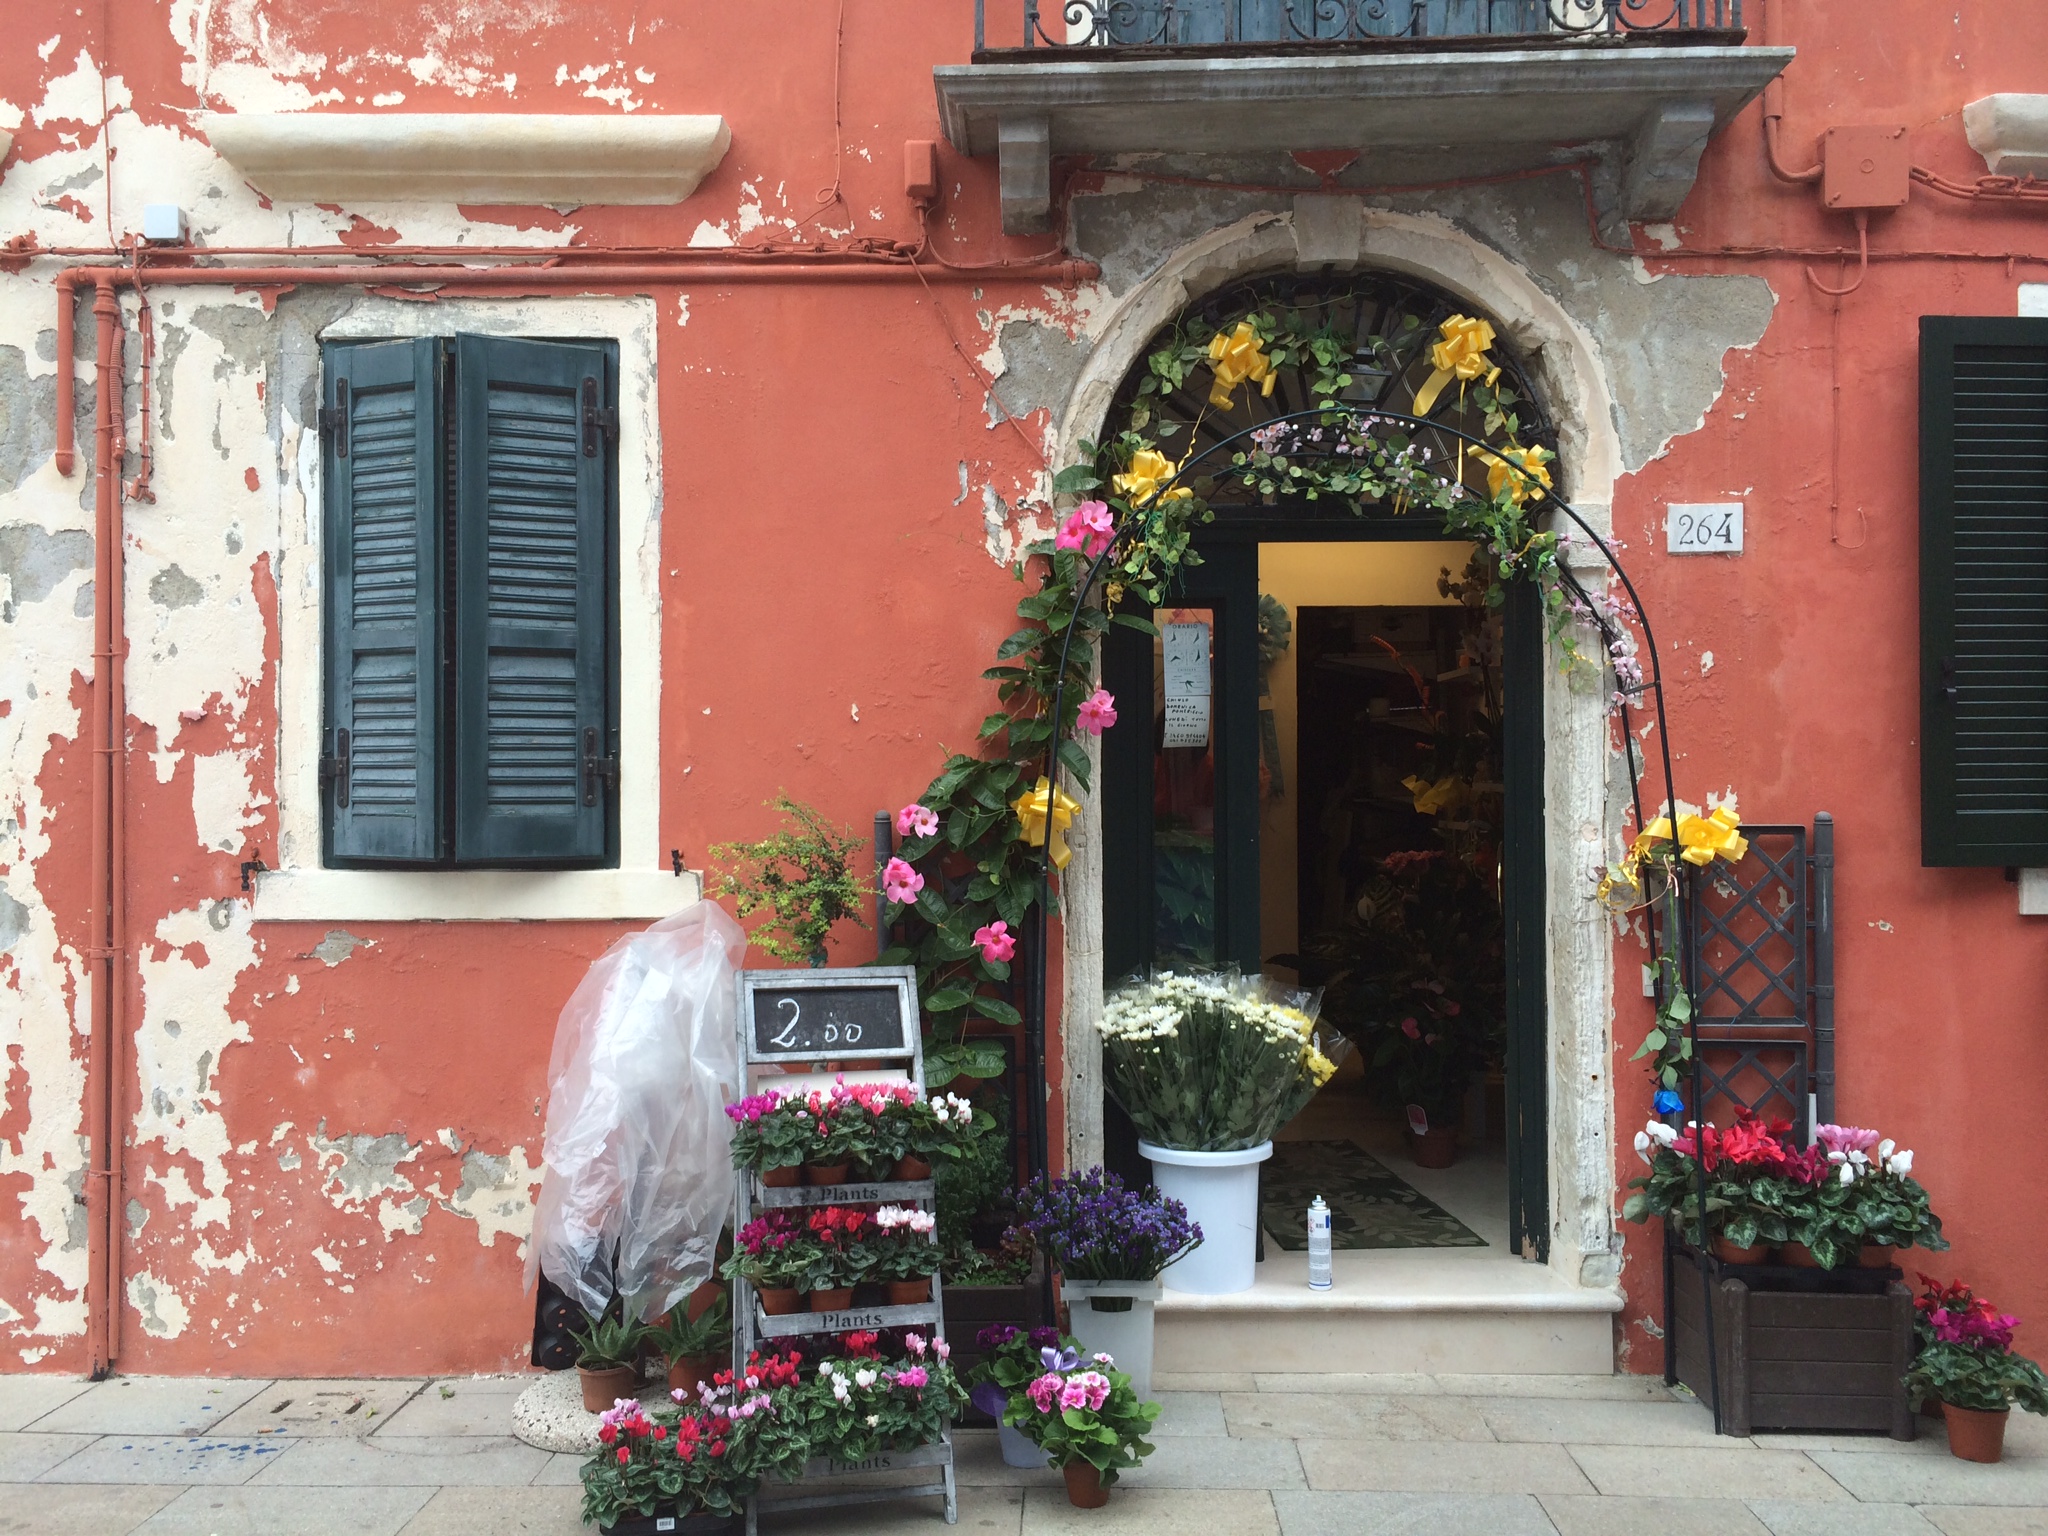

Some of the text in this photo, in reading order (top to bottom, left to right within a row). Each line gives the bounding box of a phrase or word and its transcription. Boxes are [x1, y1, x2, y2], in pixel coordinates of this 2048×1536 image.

[1678, 512, 1733, 546] 264
[770, 998, 863, 1048] 2.00
[821, 1187, 879, 1201] Plants
[822, 1313, 883, 1328] Plants
